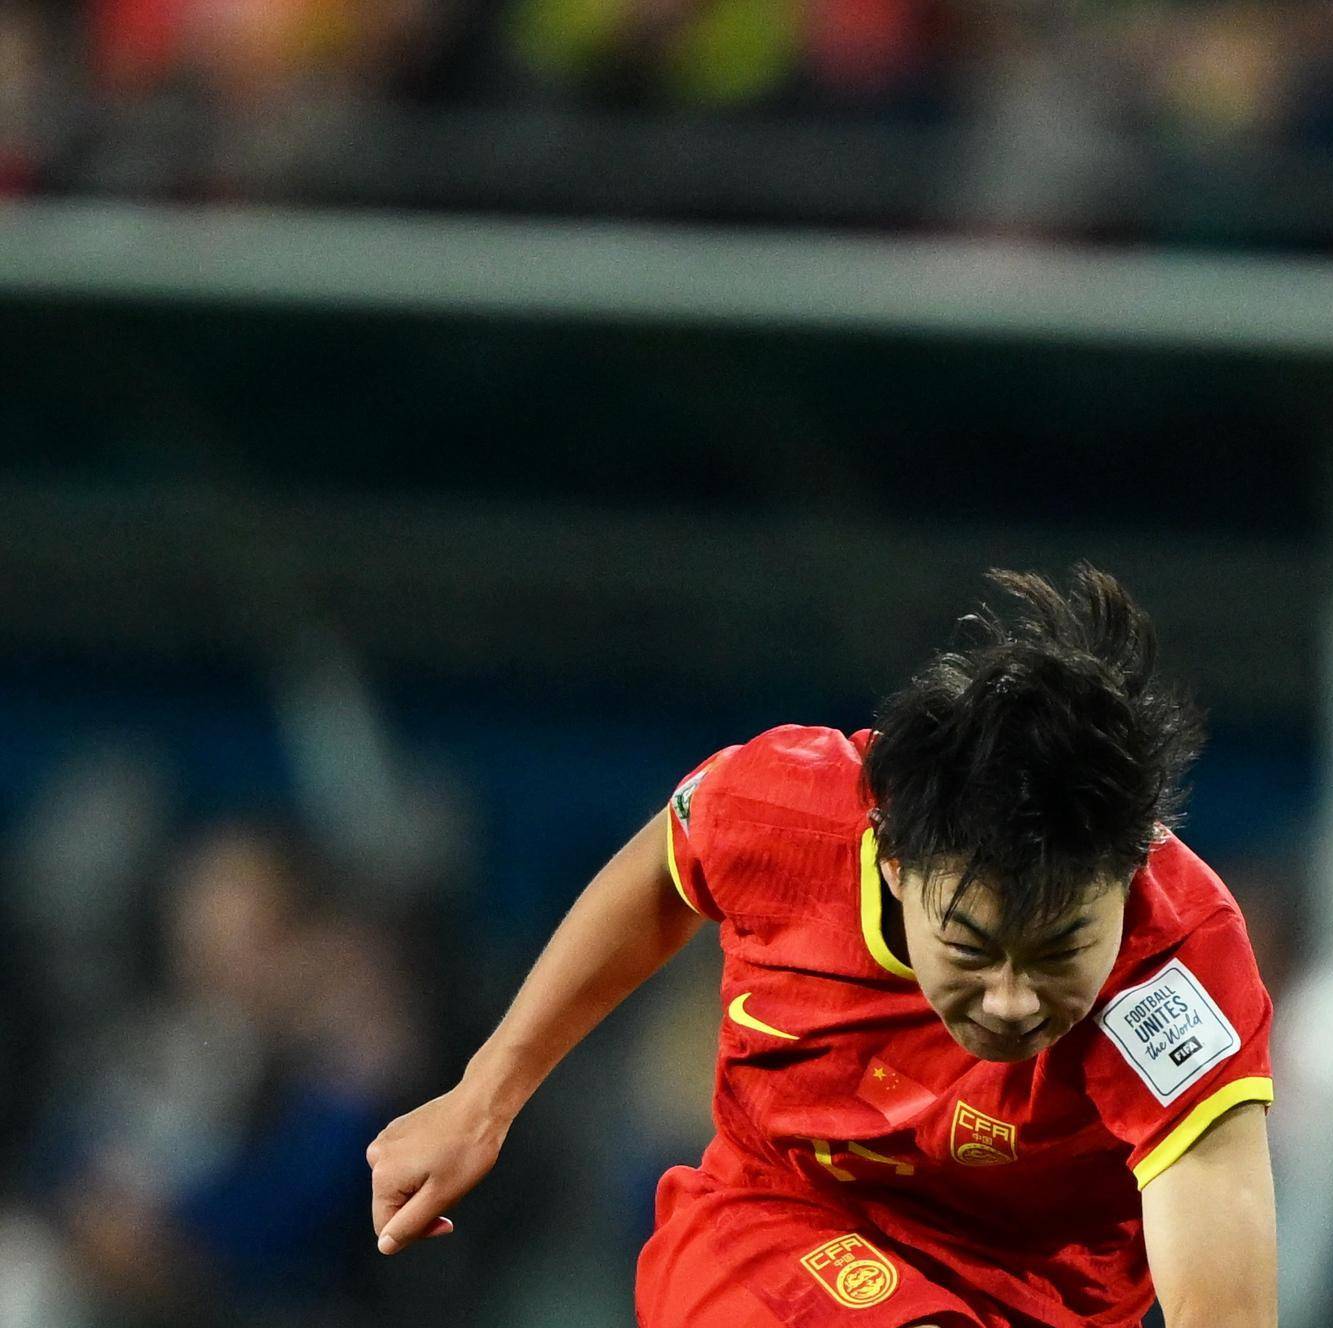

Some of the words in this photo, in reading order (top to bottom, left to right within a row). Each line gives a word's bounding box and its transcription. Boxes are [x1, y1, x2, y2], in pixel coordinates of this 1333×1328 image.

[1124, 985, 1176, 1028] FOOTBALL
[1134, 995, 1189, 1043] UNITES
[1144, 1040, 1167, 1061] the
[1163, 1009, 1203, 1045] World
[1171, 1039, 1201, 1063] FIFA
[957, 1108, 1010, 1142] CFA
[808, 1237, 865, 1271] CFA
